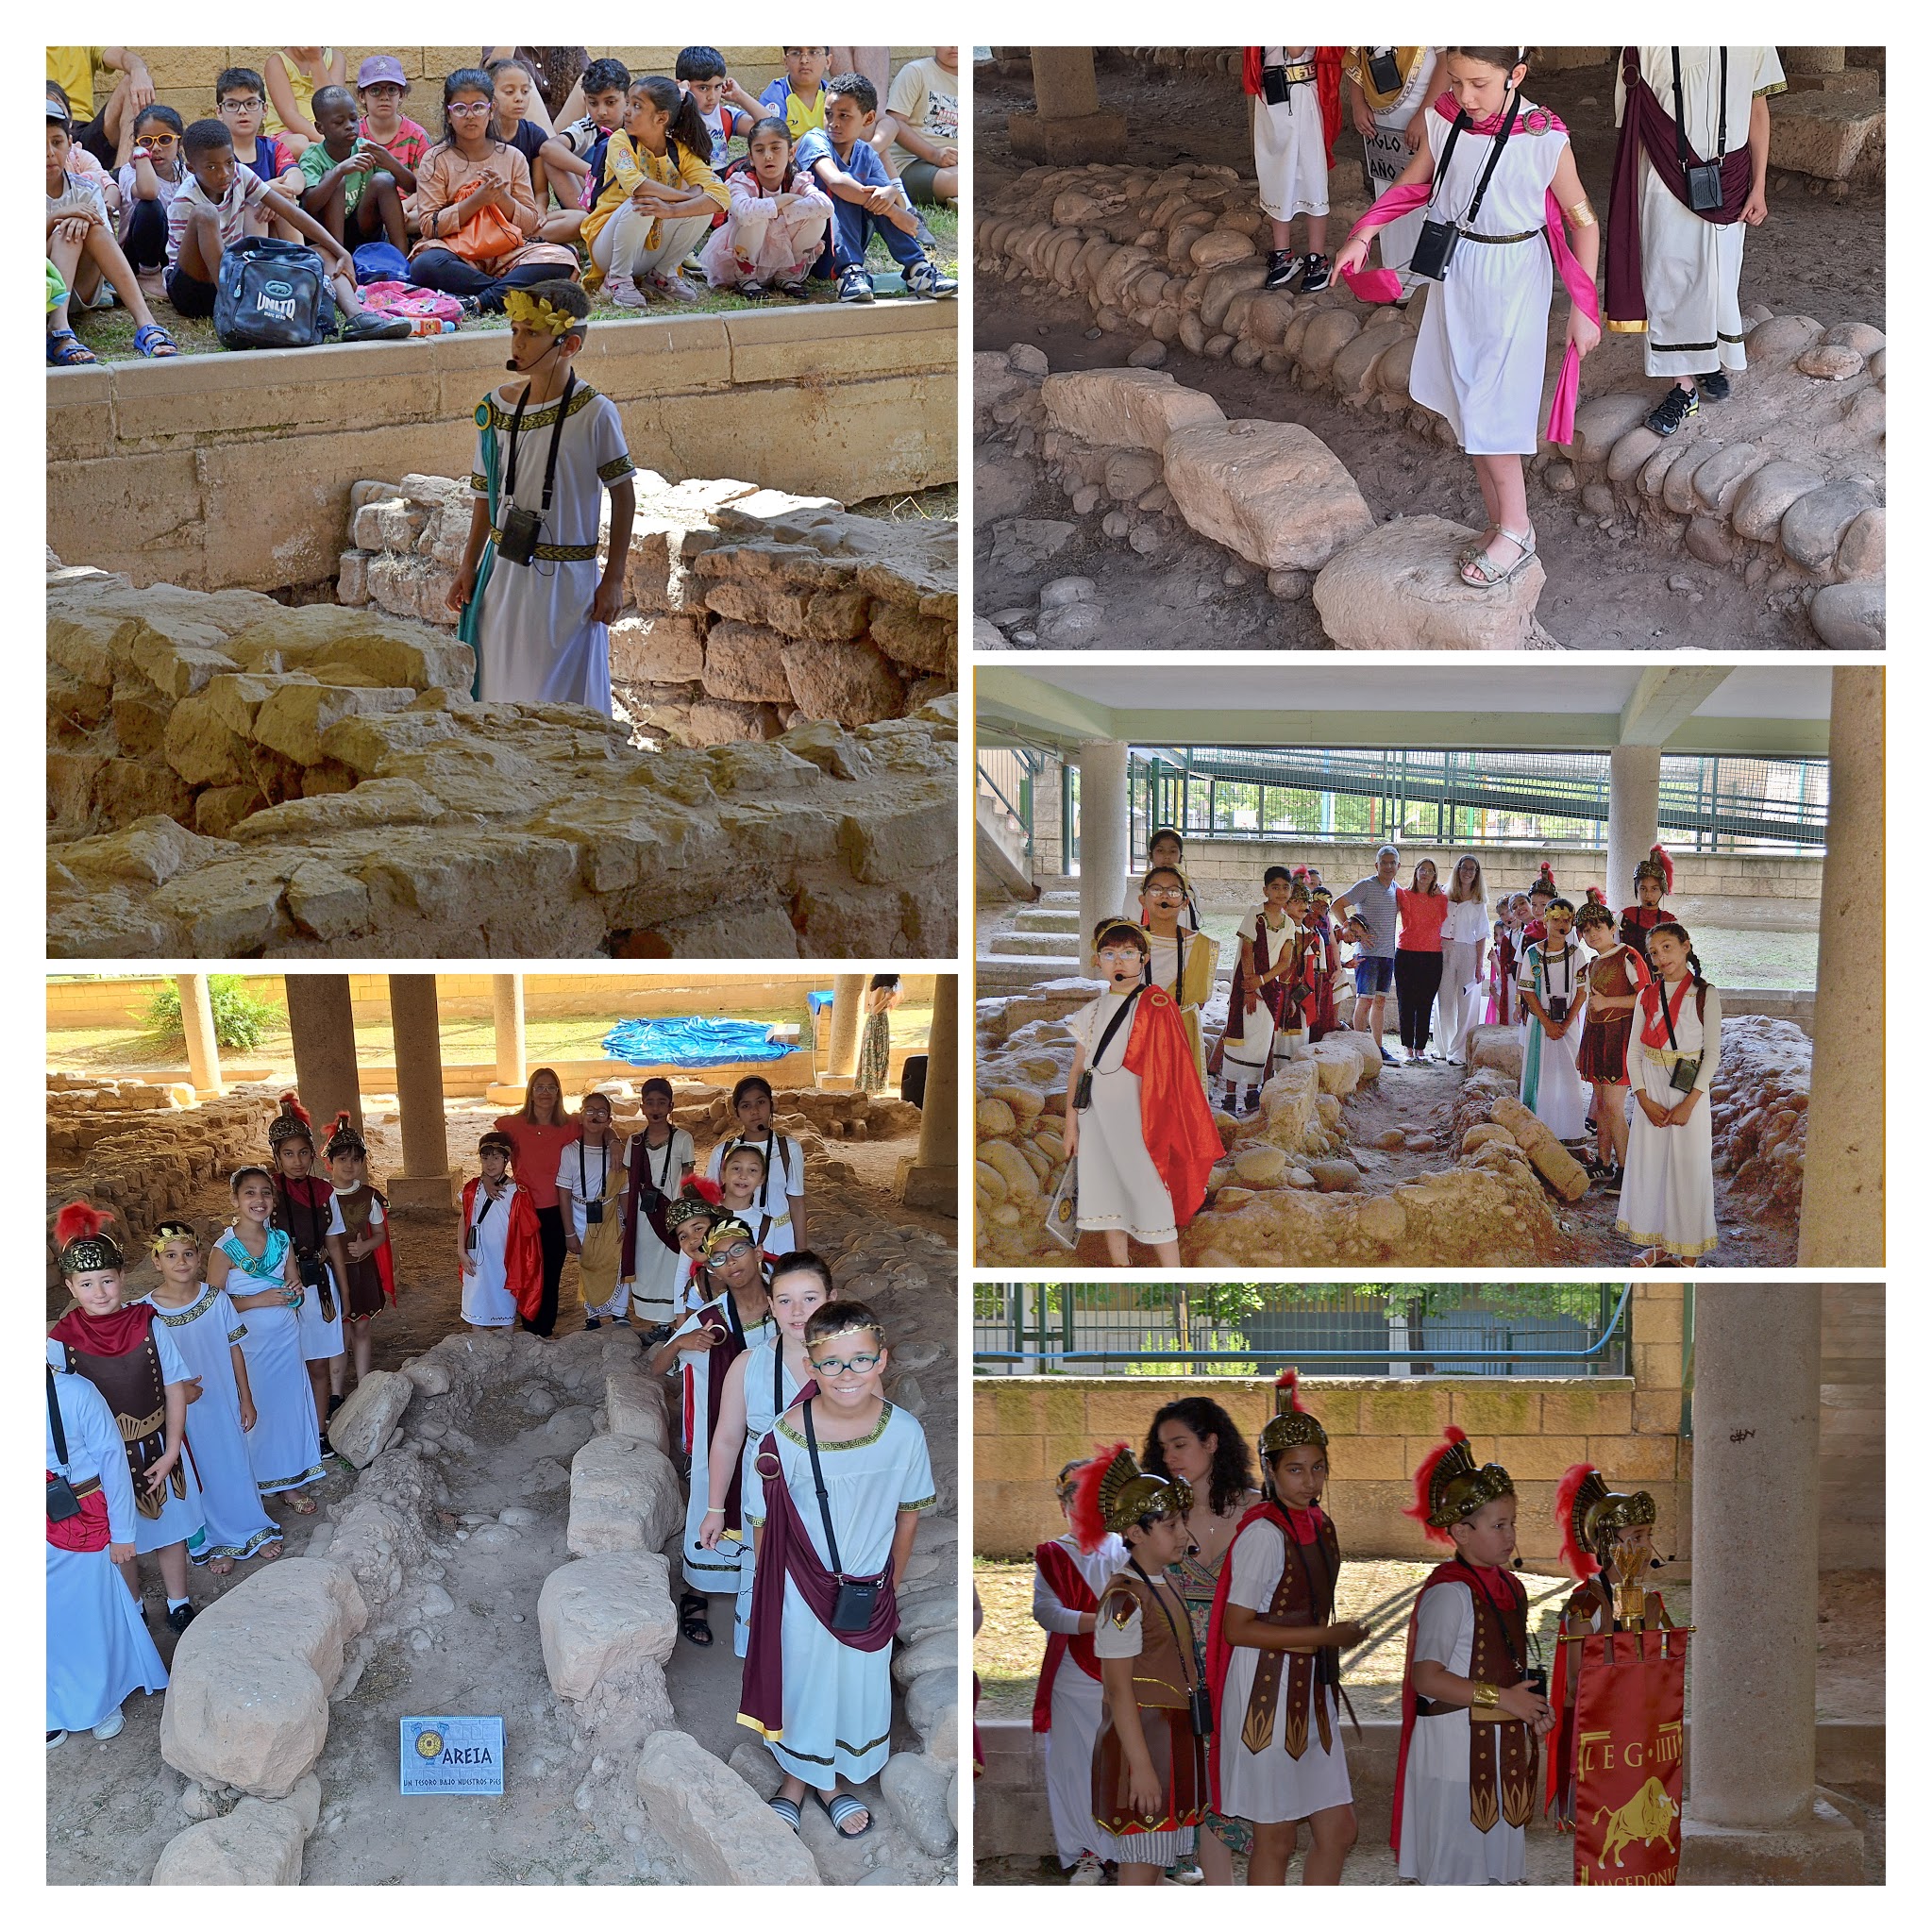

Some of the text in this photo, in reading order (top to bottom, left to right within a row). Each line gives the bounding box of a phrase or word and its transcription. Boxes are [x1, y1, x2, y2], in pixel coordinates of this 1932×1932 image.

[1370, 159, 1396, 179] AÑO
[442, 1747, 493, 1765] AREIA
[415, 1778, 437, 1787] TESORO
